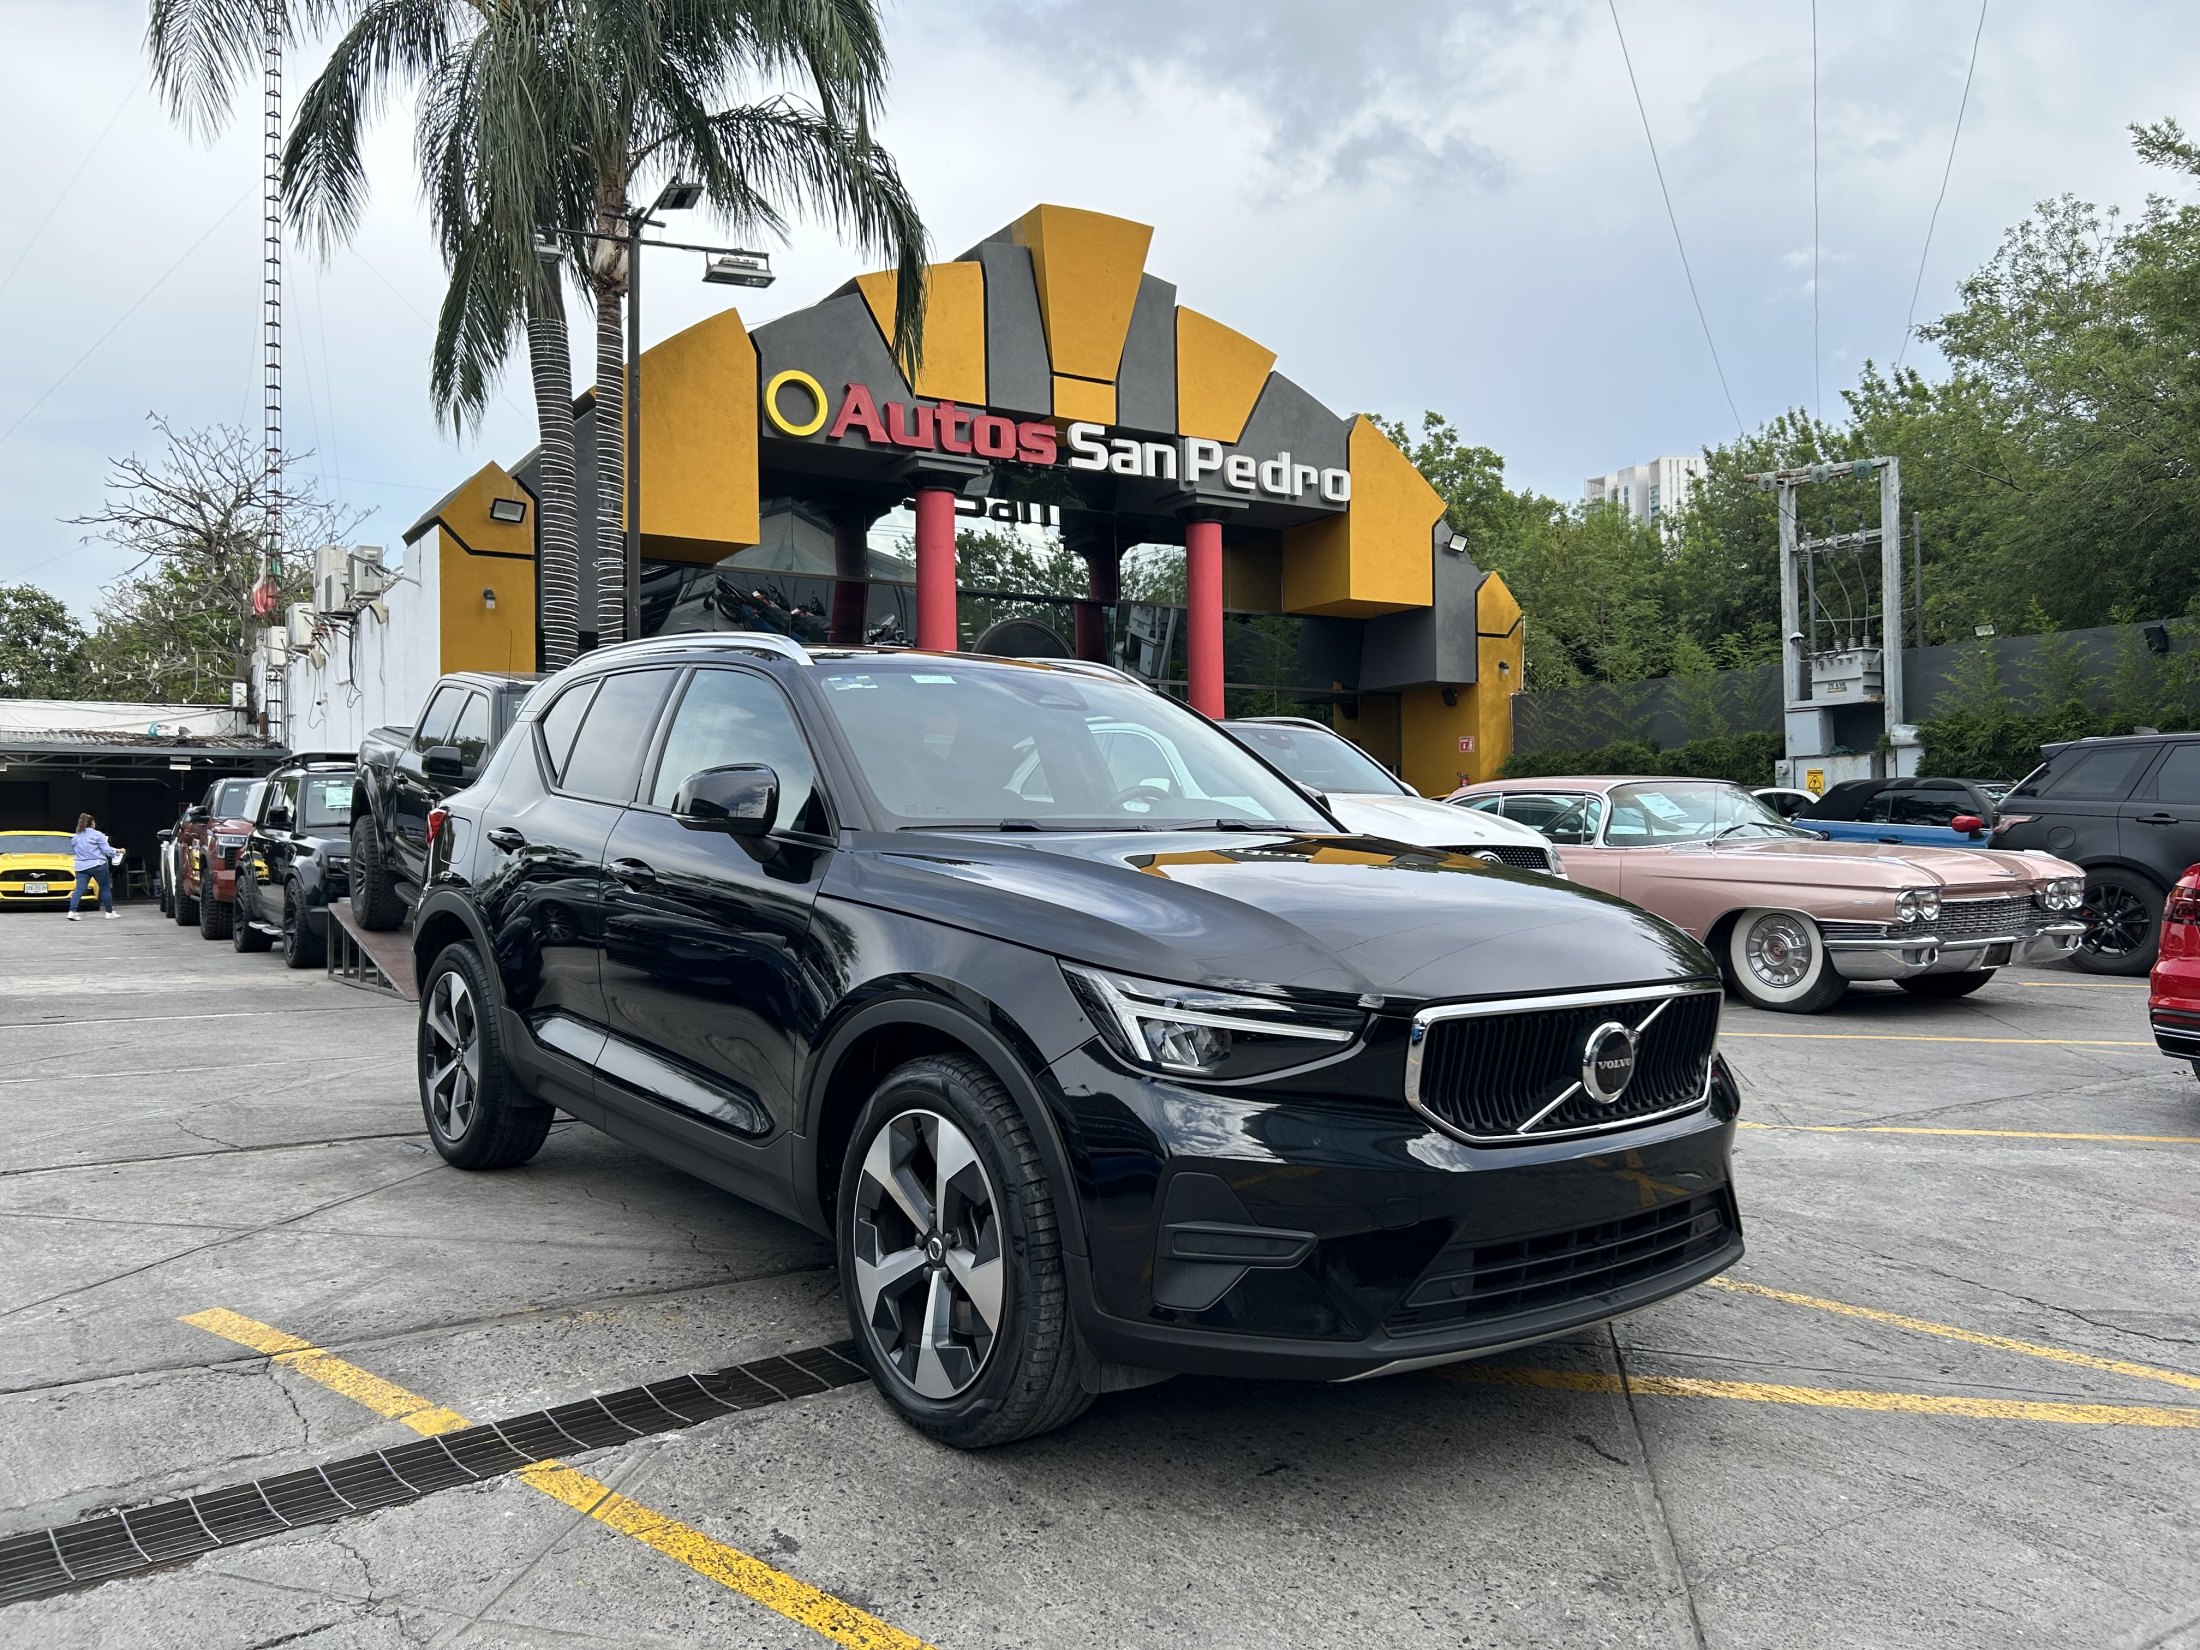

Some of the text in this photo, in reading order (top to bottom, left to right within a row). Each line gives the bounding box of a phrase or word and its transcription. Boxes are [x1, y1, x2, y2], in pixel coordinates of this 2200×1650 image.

[829, 383, 1351, 503] Autos San Pedro
[1597, 1057, 1632, 1070] VOLVO
